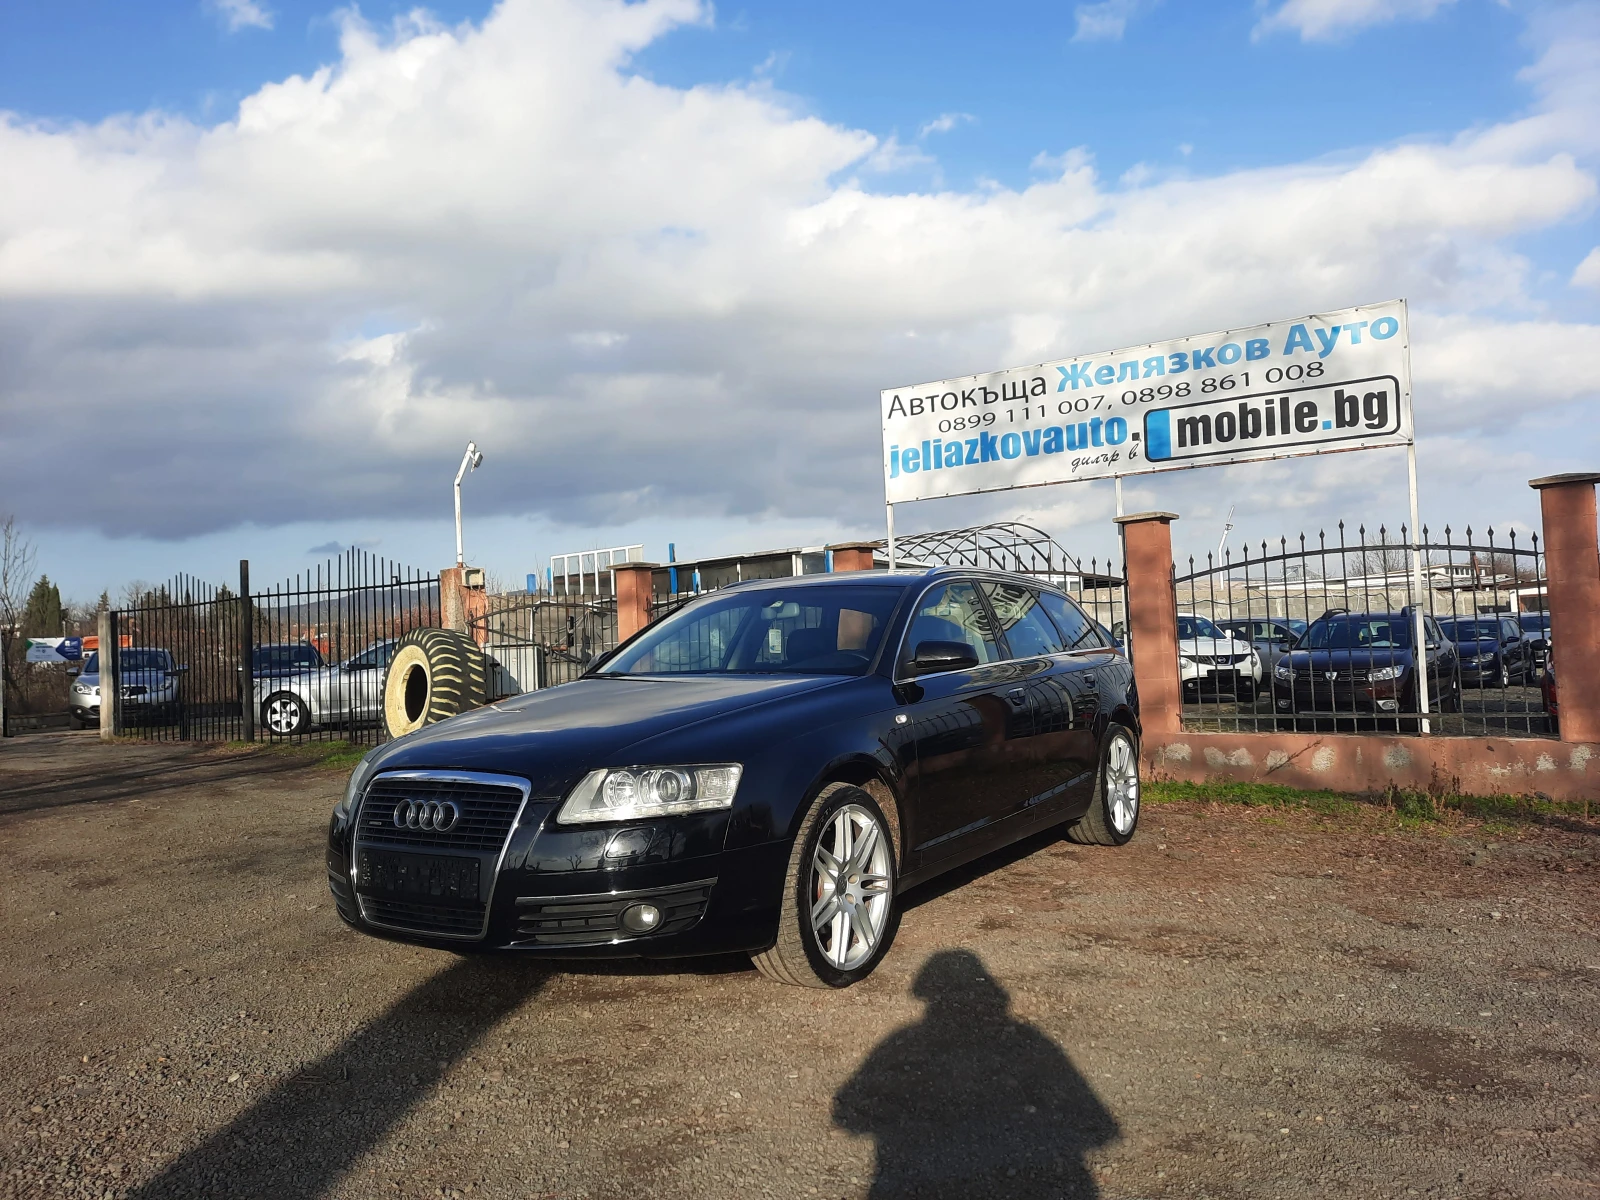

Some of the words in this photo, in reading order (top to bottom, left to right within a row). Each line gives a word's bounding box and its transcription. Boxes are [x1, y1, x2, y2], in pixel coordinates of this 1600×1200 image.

[887, 375, 1047, 419] Автокъща
[1056, 337, 1271, 393] Желязков
[1282, 315, 1400, 359] Ауто
[938, 412, 997, 433] 0899
[1006, 404, 1046, 423] 111
[1058, 395, 1112, 415] 007,
[1121, 381, 1192, 406] 0898
[1200, 372, 1250, 394] 861
[1265, 361, 1325, 384] 008
[1177, 389, 1389, 448] mobile.bg
[1071, 449, 1121, 473] дилър
[1128, 443, 1140, 460] в
